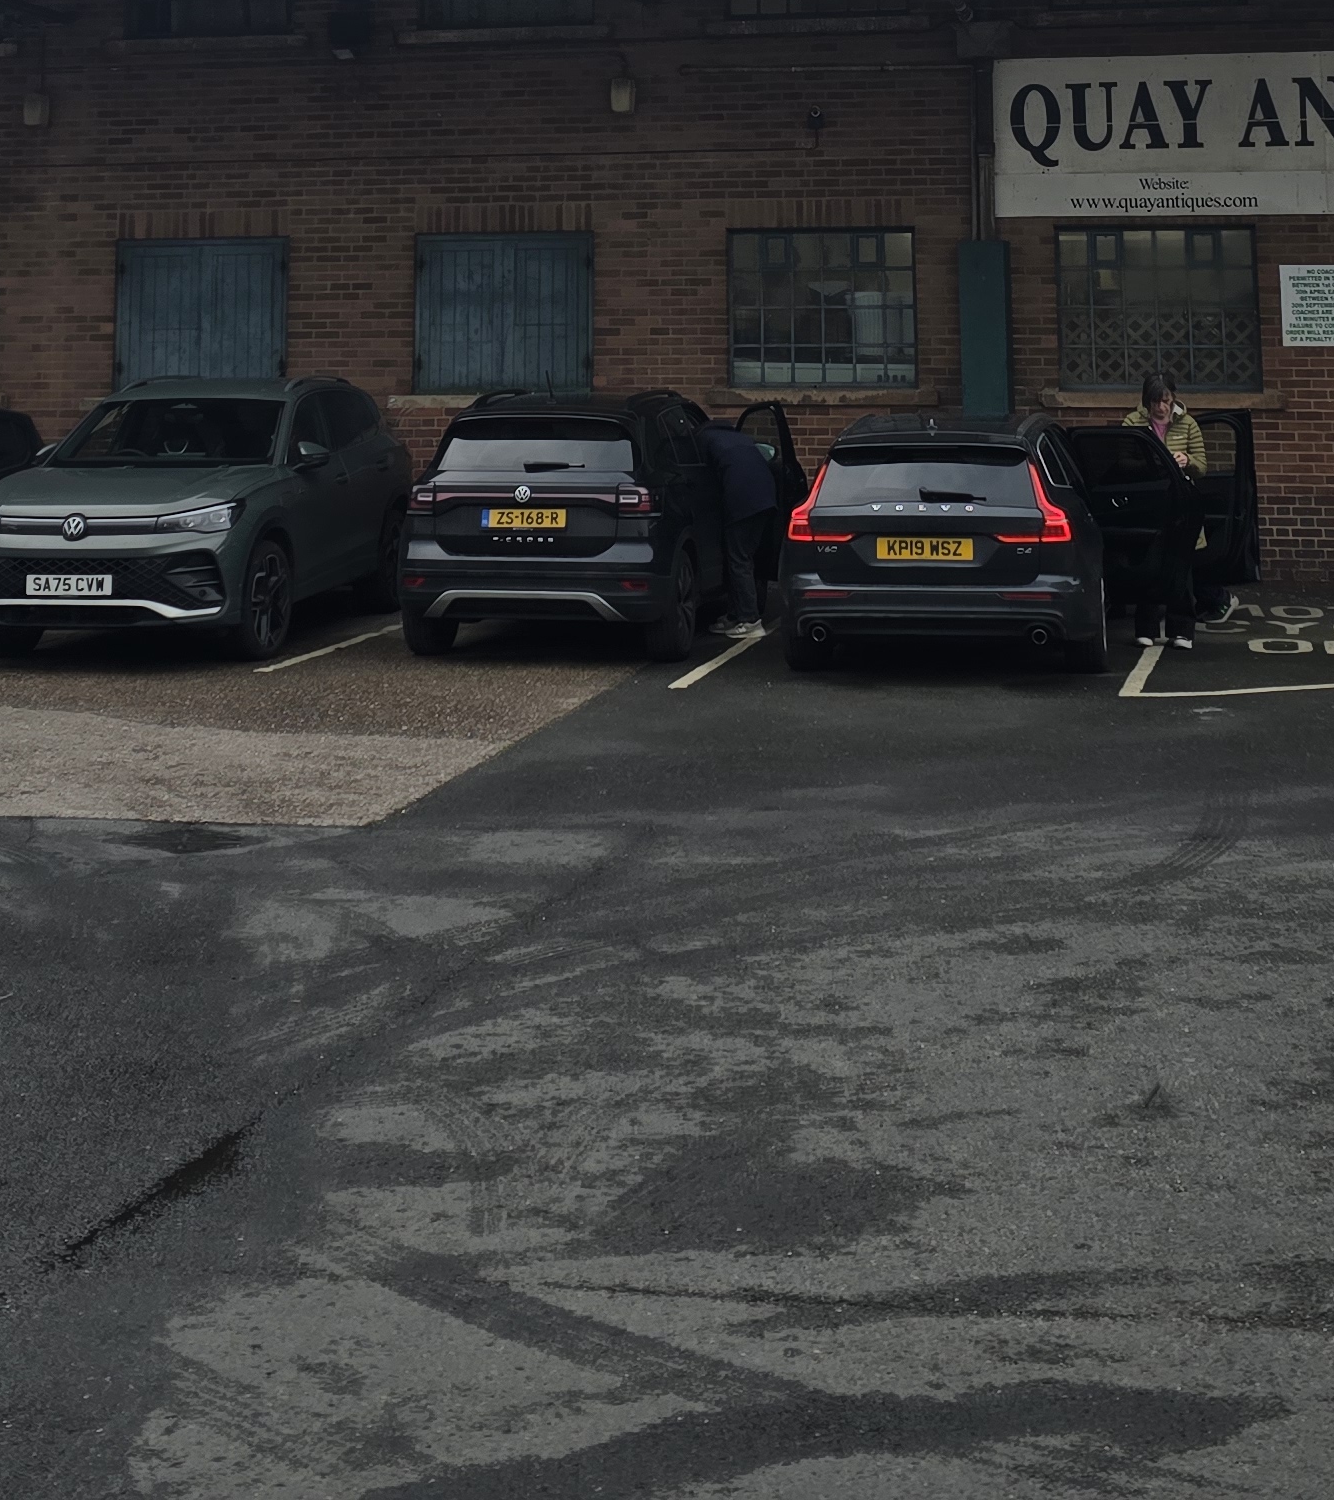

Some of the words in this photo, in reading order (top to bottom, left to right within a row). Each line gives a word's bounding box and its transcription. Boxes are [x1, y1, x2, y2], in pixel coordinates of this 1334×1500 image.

[1009, 78, 1213, 167] QUAY
[1139, 178, 1190, 191] Website:
[1070, 192, 1259, 212] www.quayantiques.com
[871, 504, 974, 512] VOLVO
[496, 511, 559, 525] ZS-168-R
[886, 540, 924, 556] KP19
[929, 540, 962, 556] WSZ
[32, 576, 72, 592] SA75
[75, 576, 105, 592] CVW
